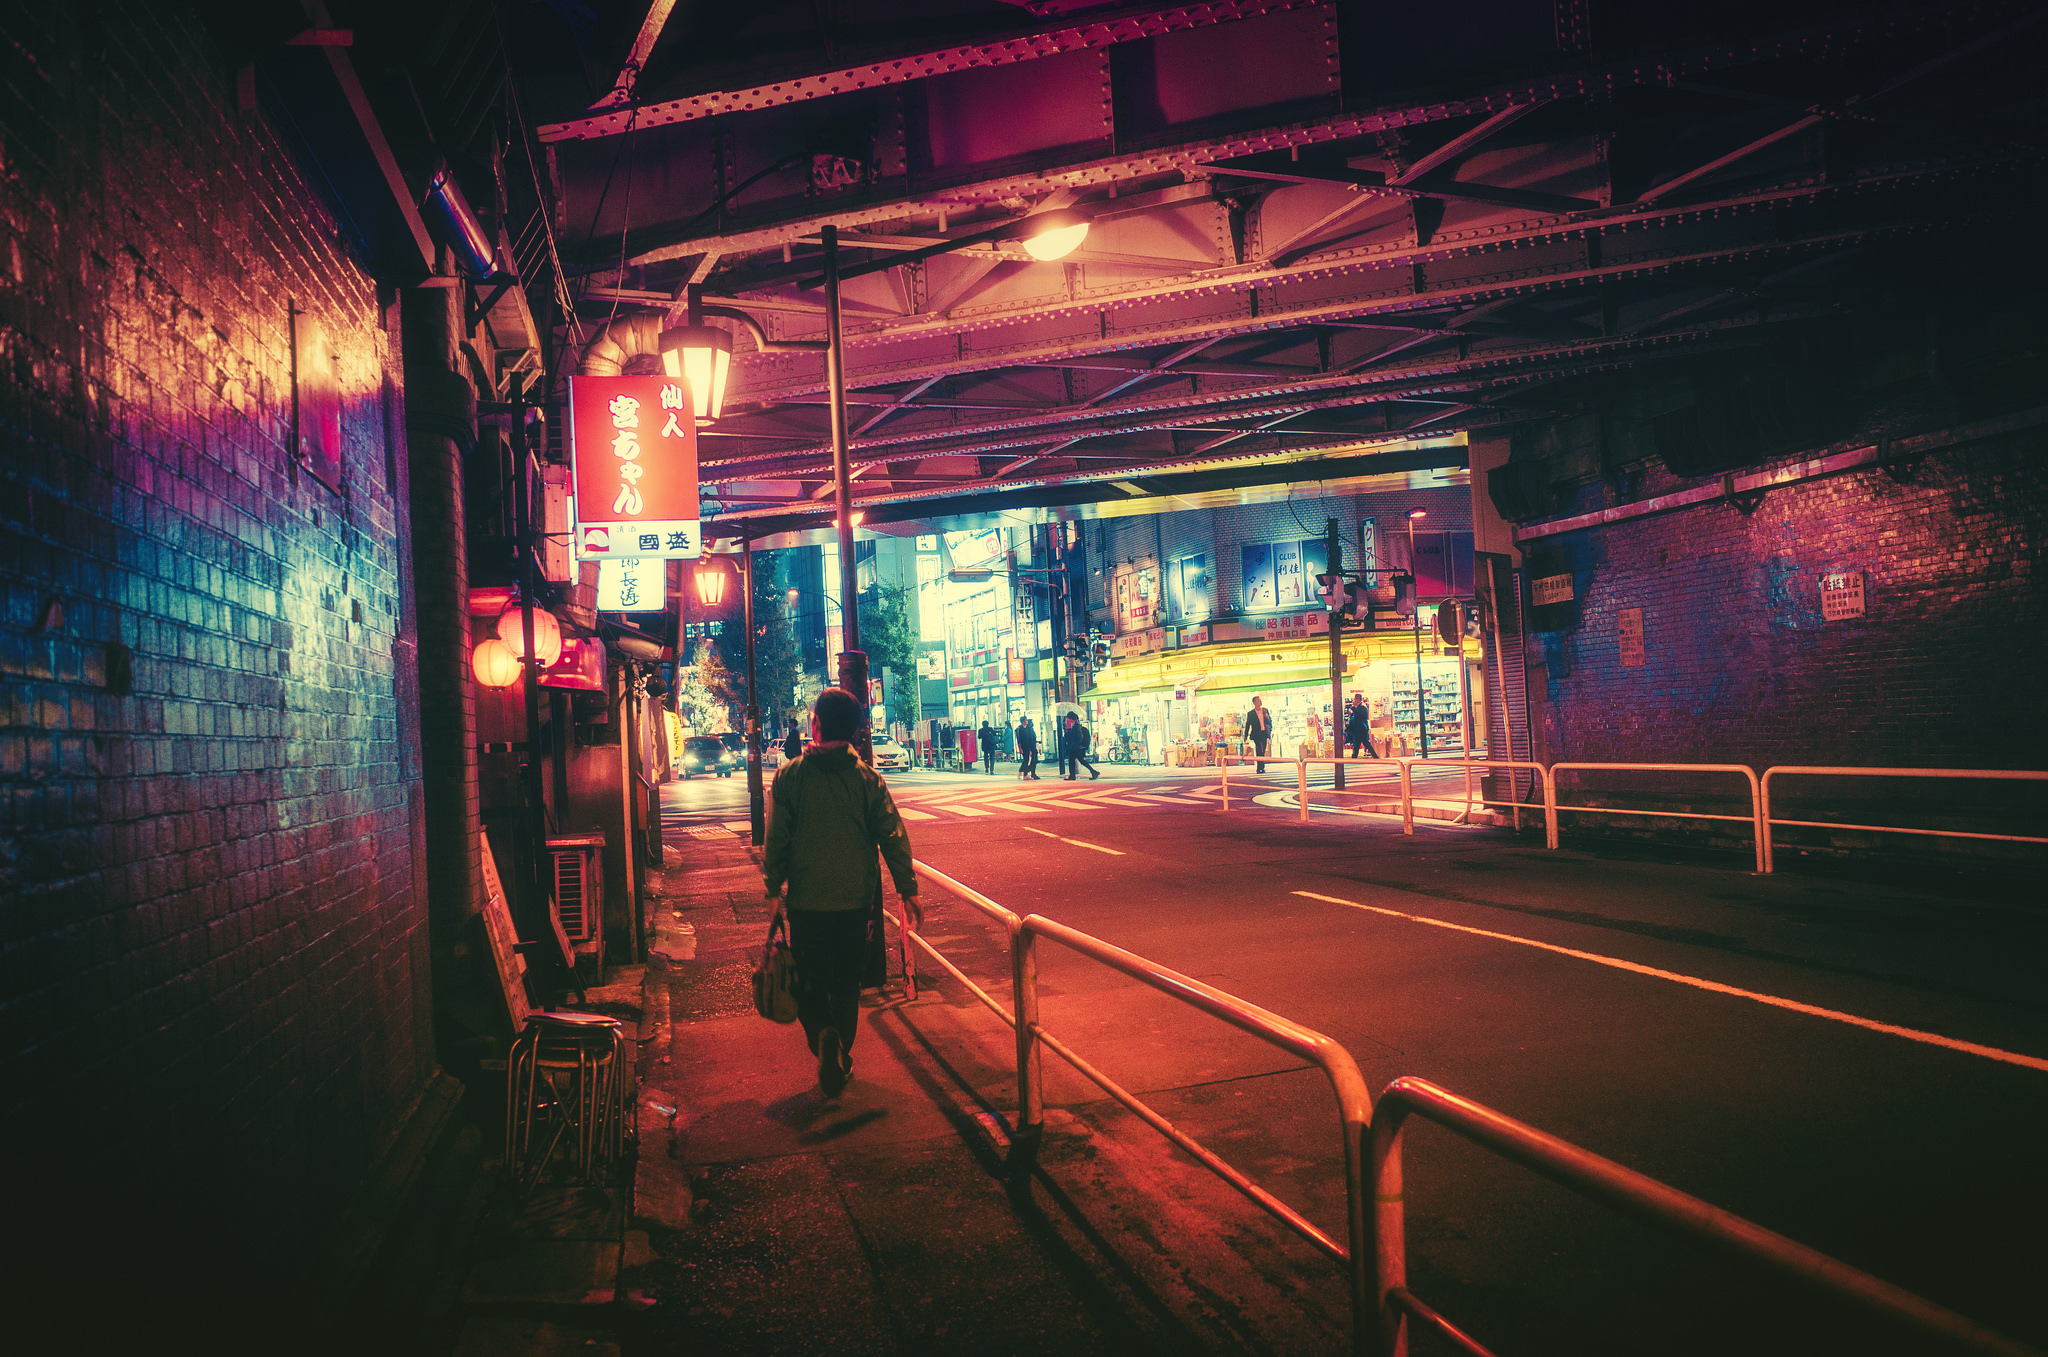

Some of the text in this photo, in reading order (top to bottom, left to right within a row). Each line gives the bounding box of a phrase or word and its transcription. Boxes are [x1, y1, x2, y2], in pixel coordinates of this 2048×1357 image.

[659, 383, 686, 438] 仙人
[608, 394, 644, 516] 宮ちゃん
[638, 530, 691, 551] 國盛
[1279, 552, 1297, 561] CLUB
[1365, 526, 1375, 581] クスリ
[1416, 546, 1441, 554] CLUB
